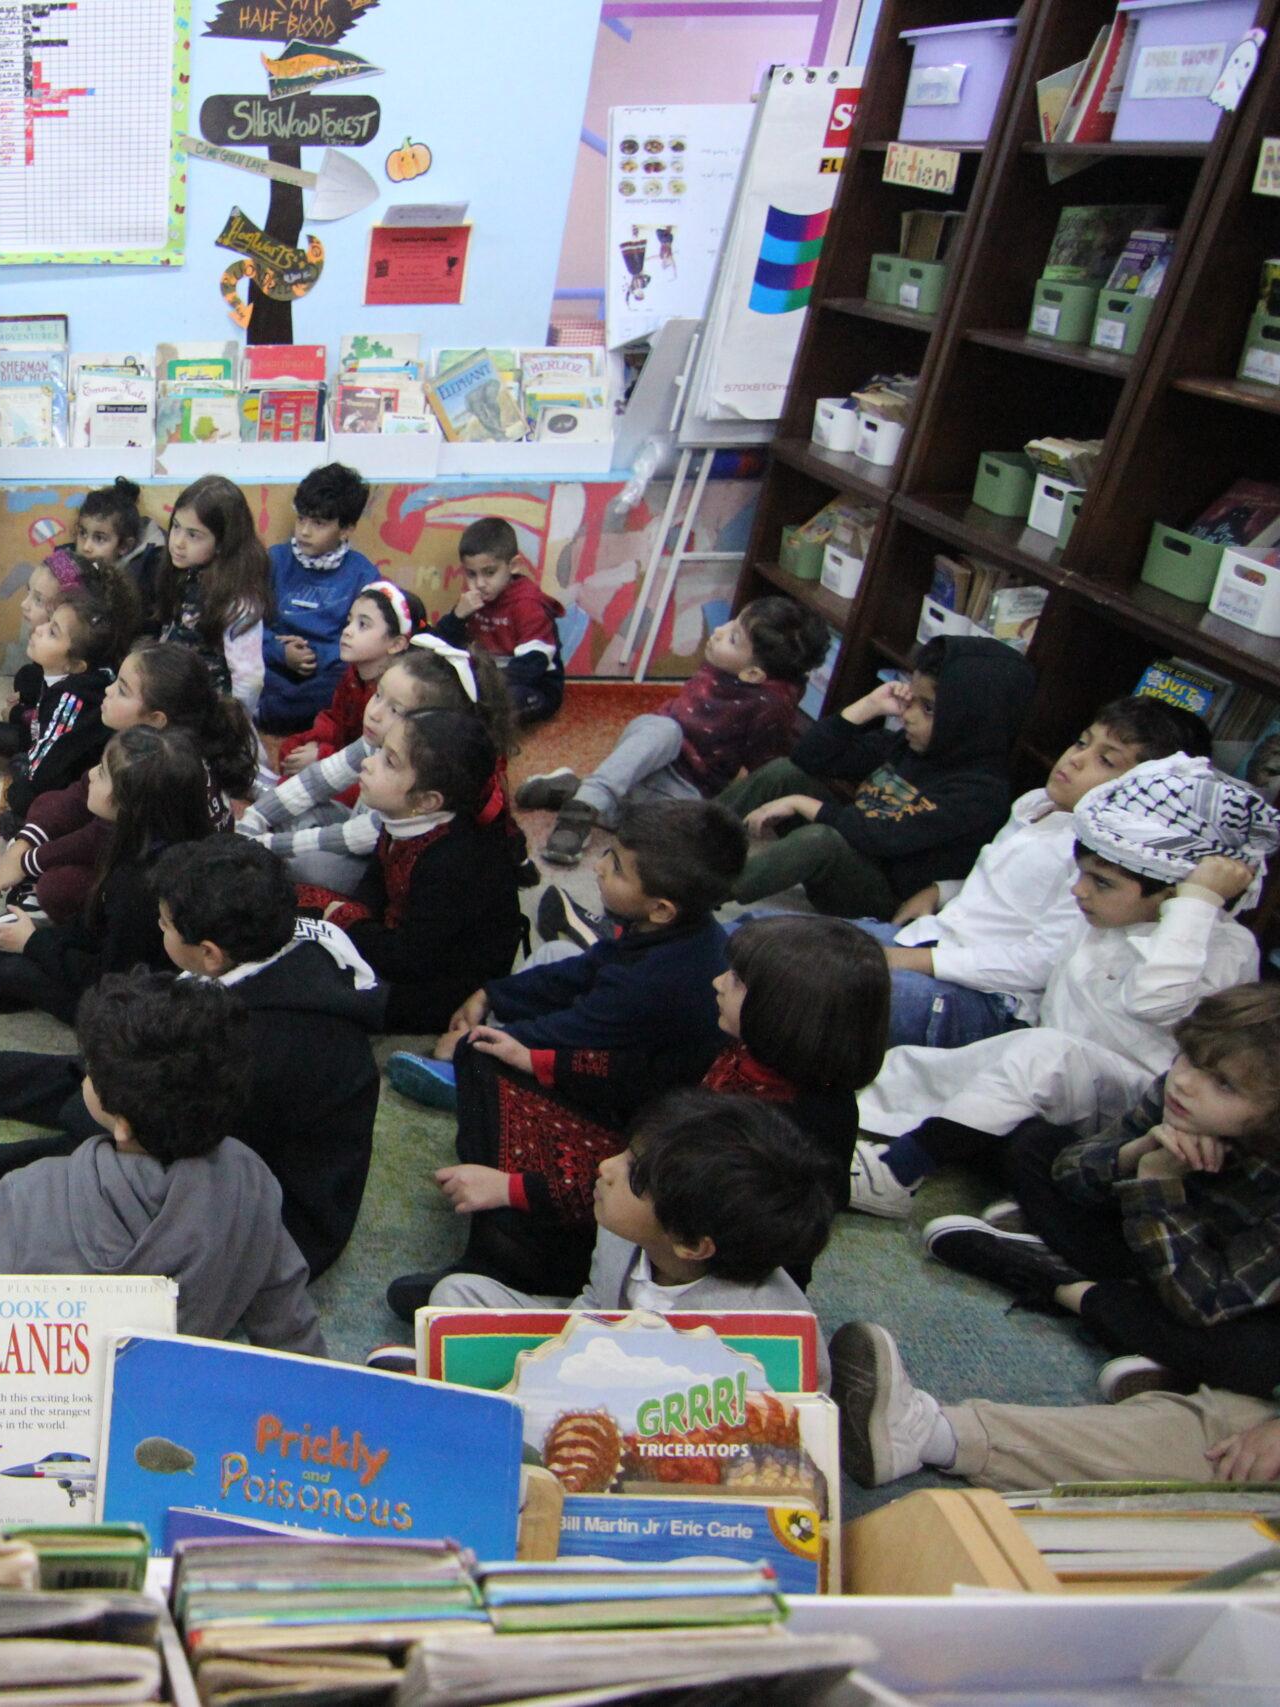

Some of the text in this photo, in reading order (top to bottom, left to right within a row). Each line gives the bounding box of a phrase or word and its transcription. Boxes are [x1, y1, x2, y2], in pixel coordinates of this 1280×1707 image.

[238, 6, 336, 38] HALF-BLOOD
[0, 333, 58, 341] ADVENTURES
[0, 360, 49, 372] SHERMAN
[530, 360, 584, 374] BERLIOZ
[436, 362, 492, 400] ELEPHANT
[1159, 677, 1200, 700] JUST
[7, 1285, 58, 1293] PLANES
[80, 1285, 159, 1294] BLACKBIRD
[57, 1300, 87, 1318] OF
[10, 1393, 27, 1402] this
[30, 1393, 70, 1404] exciting
[72, 1393, 94, 1402] look
[635, 1370, 749, 1438] GRRR!
[9, 1406, 27, 1415] and
[30, 1406, 45, 1415] the
[48, 1407, 91, 1417] strangest
[6, 1420, 15, 1429] in
[18, 1420, 34, 1429] the
[255, 1412, 390, 1487] Prickly
[636, 1443, 750, 1458] TRICERATOPS
[301, 1470, 331, 1484] and
[221, 1451, 414, 1531] Poisonous
[560, 1516, 580, 1531] Bill
[585, 1517, 639, 1534] Martin
[642, 1518, 660, 1535] Jr
[670, 1520, 703, 1536] Eric
[707, 1521, 753, 1539] Carle
